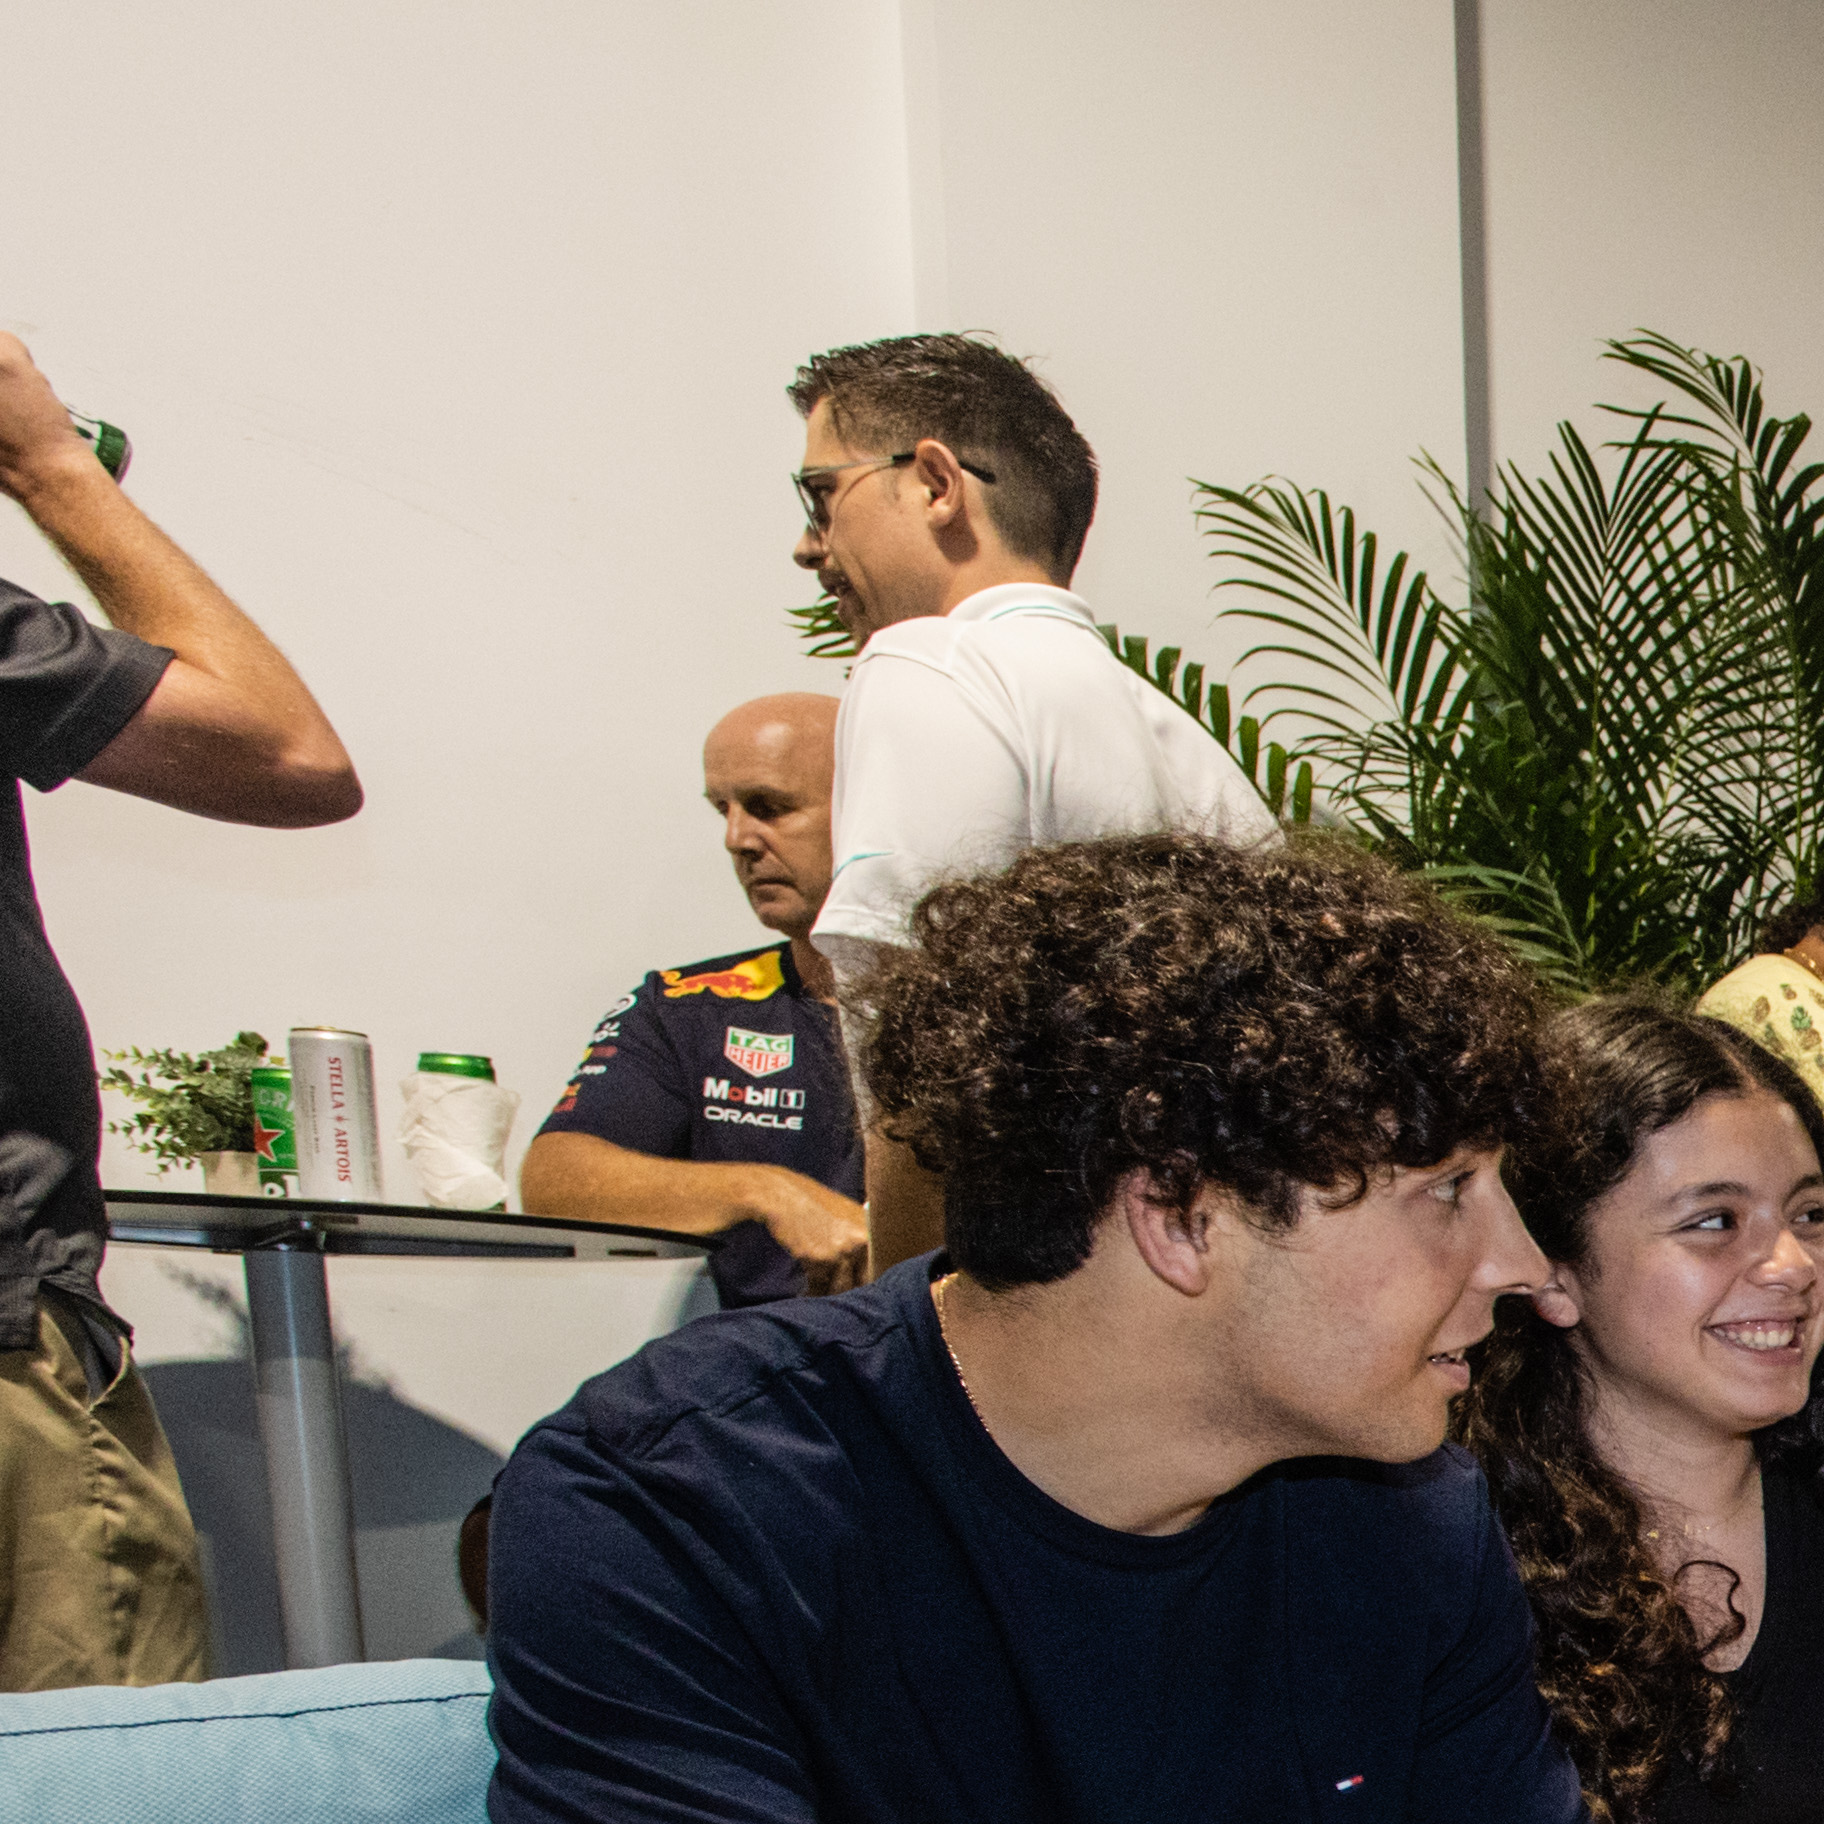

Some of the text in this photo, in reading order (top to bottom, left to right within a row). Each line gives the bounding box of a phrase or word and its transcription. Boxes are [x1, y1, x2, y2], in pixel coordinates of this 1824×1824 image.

[732, 1031, 789, 1053] TAG
[729, 1046, 789, 1073] HEUER
[703, 1076, 778, 1108] Mobil
[328, 1057, 352, 1182] STELLA ARTOIS
[703, 1105, 803, 1130] ORACLE
